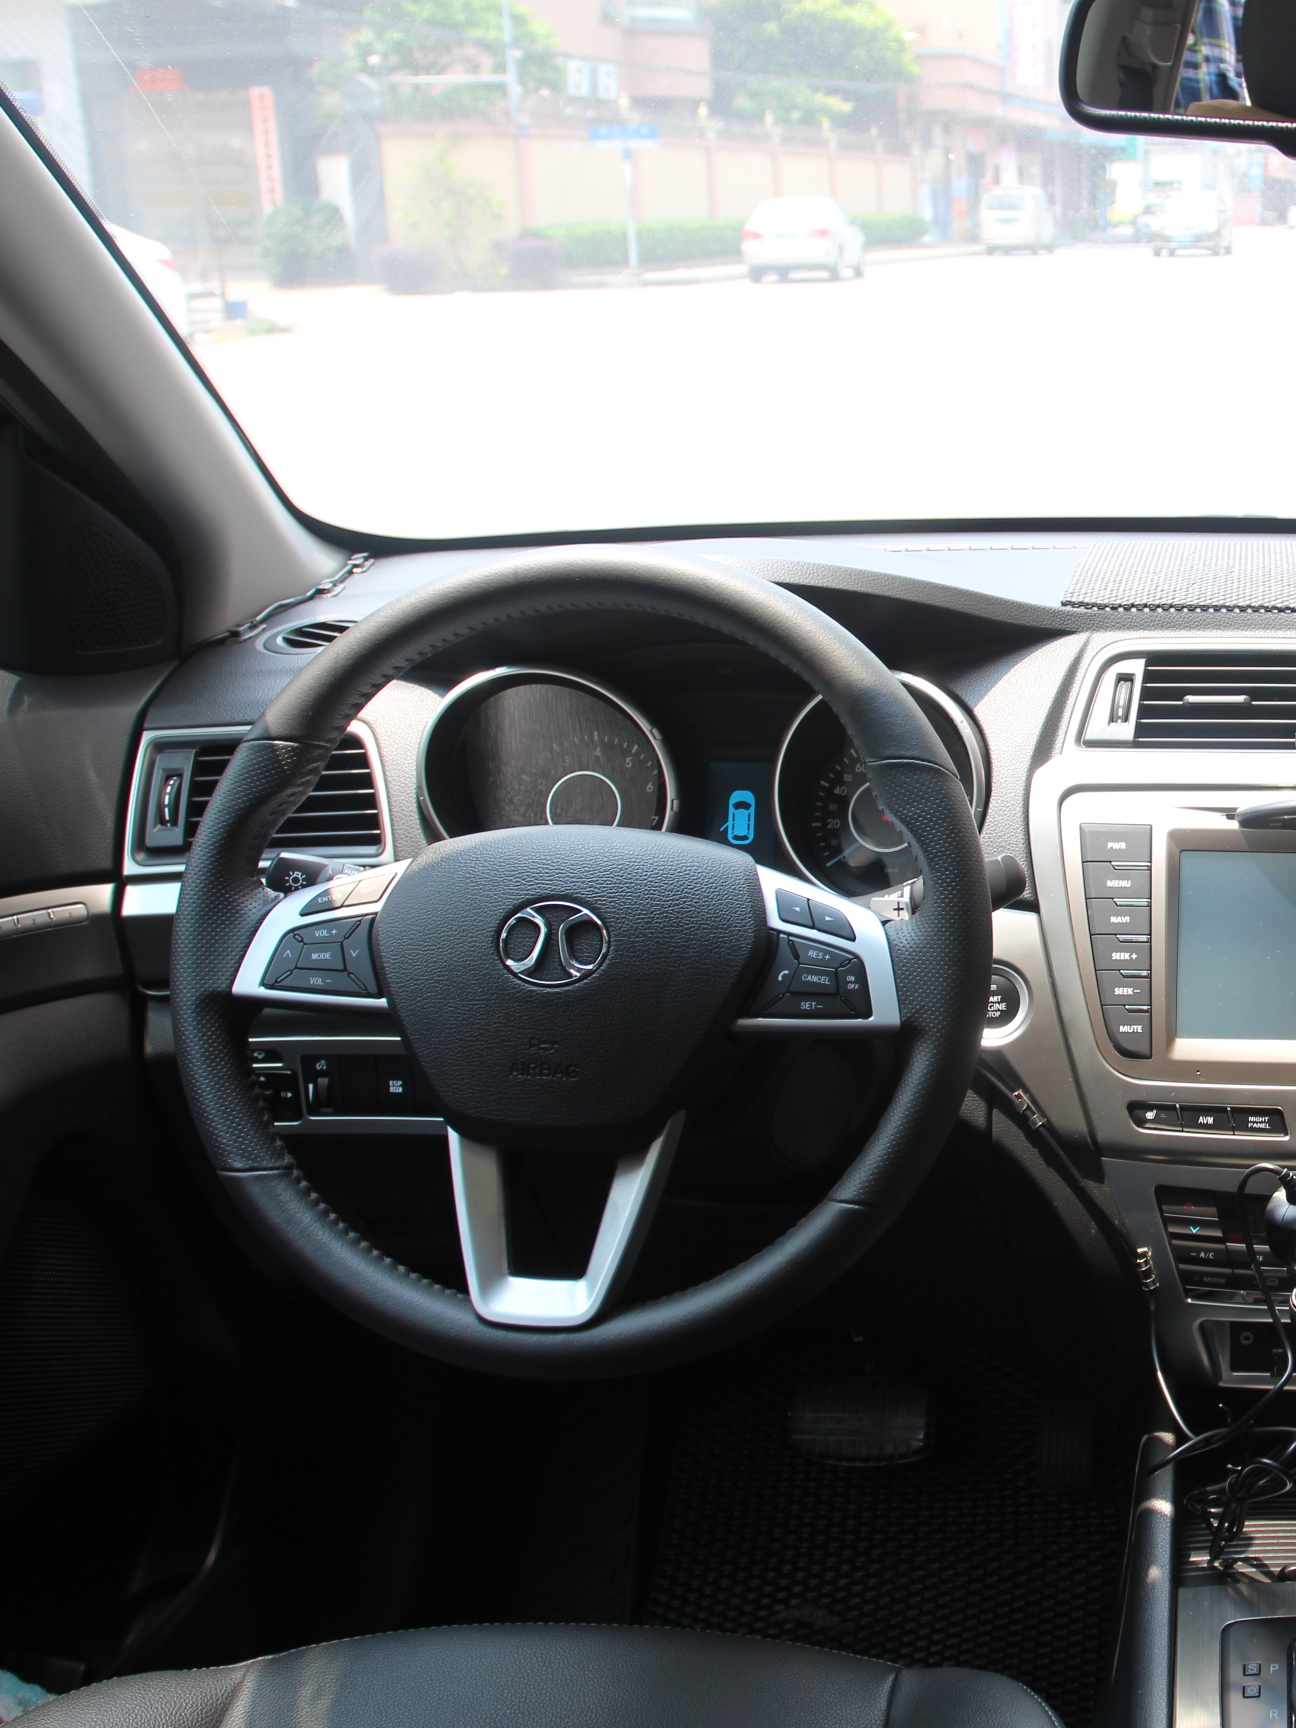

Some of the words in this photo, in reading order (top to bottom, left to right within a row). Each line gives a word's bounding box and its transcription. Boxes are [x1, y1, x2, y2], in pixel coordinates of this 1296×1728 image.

[594, 746, 601, 756] 4
[564, 755, 570, 766] 3
[625, 757, 632, 768] 5
[646, 782, 653, 792] 6
[834, 786, 847, 796] 40
[651, 816, 659, 826] 7
[827, 819, 840, 829] 20
[1107, 840, 1126, 850] PWR
[1107, 878, 1131, 888] MENU
[360, 885, 378, 894] QUIT
[318, 893, 342, 904] ENTER
[1110, 915, 1130, 924] NAVI
[311, 951, 332, 960] MODE
[802, 973, 831, 985] CANCEL
[987, 1003, 1007, 1011] GINE
[1119, 1024, 1143, 1034] MUTE
[508, 1061, 580, 1081] AIRBAG
[1198, 1116, 1214, 1125] AVM
[1199, 1251, 1215, 1259] A/C
[1203, 1276, 1226, 1284] MODE
[1270, 1664, 1279, 1674] P
[1269, 1709, 1279, 1720] R
